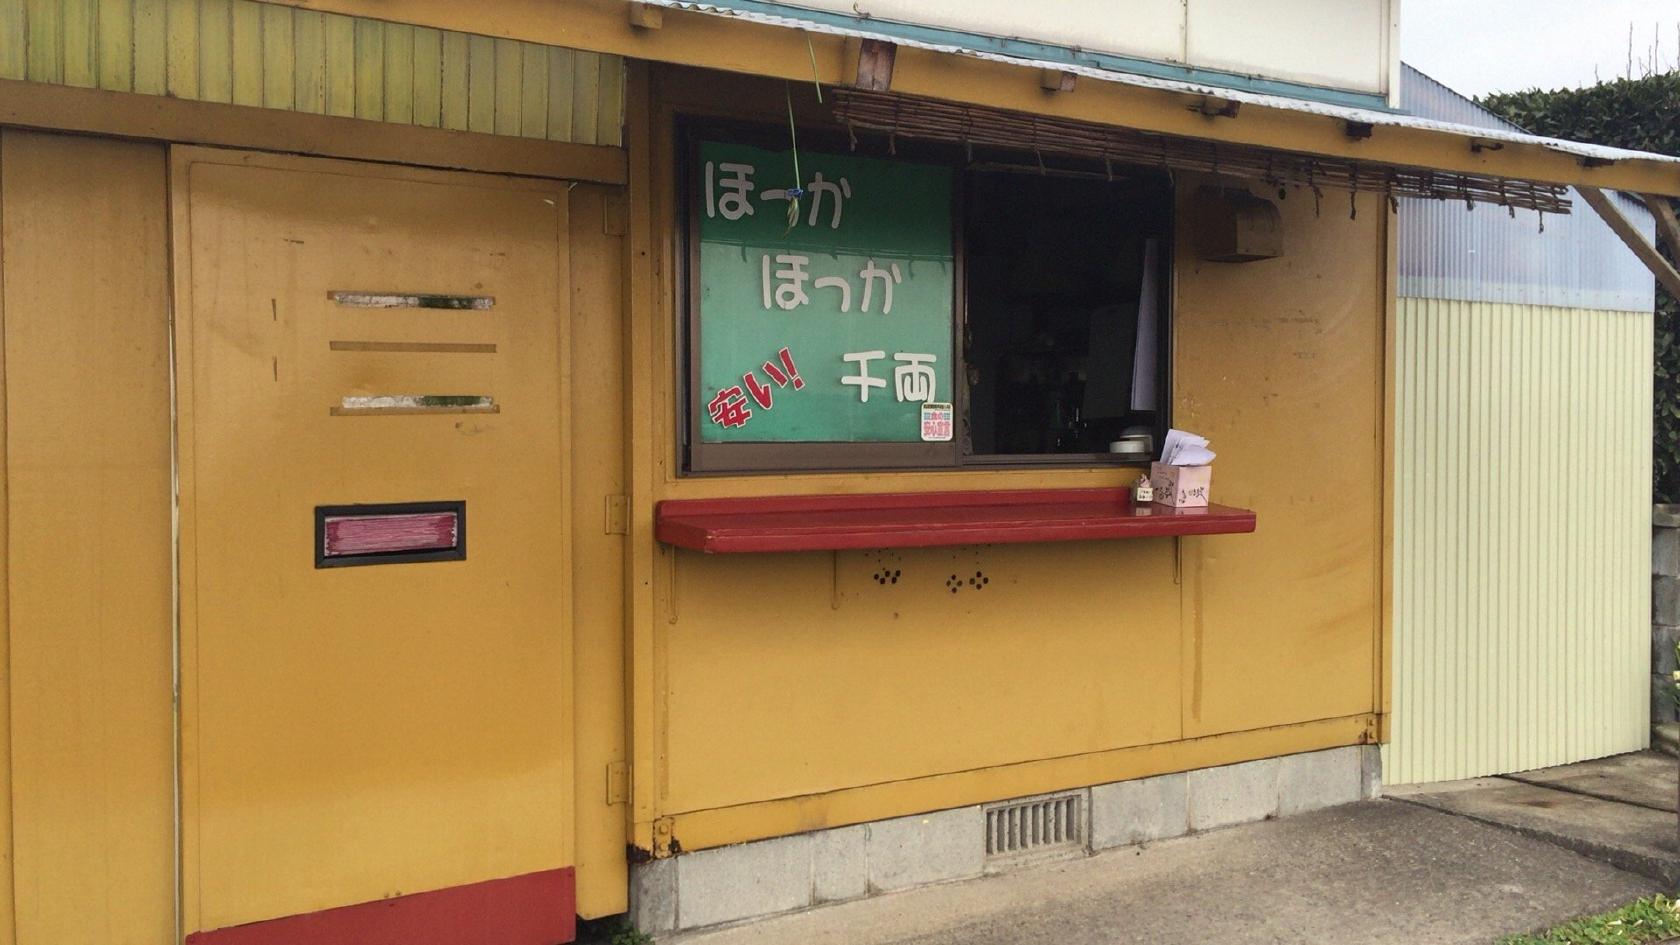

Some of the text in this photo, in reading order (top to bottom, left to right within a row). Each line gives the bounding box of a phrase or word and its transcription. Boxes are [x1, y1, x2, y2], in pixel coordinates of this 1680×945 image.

[762, 254, 902, 315] ほっか
[841, 350, 937, 402] 千両
